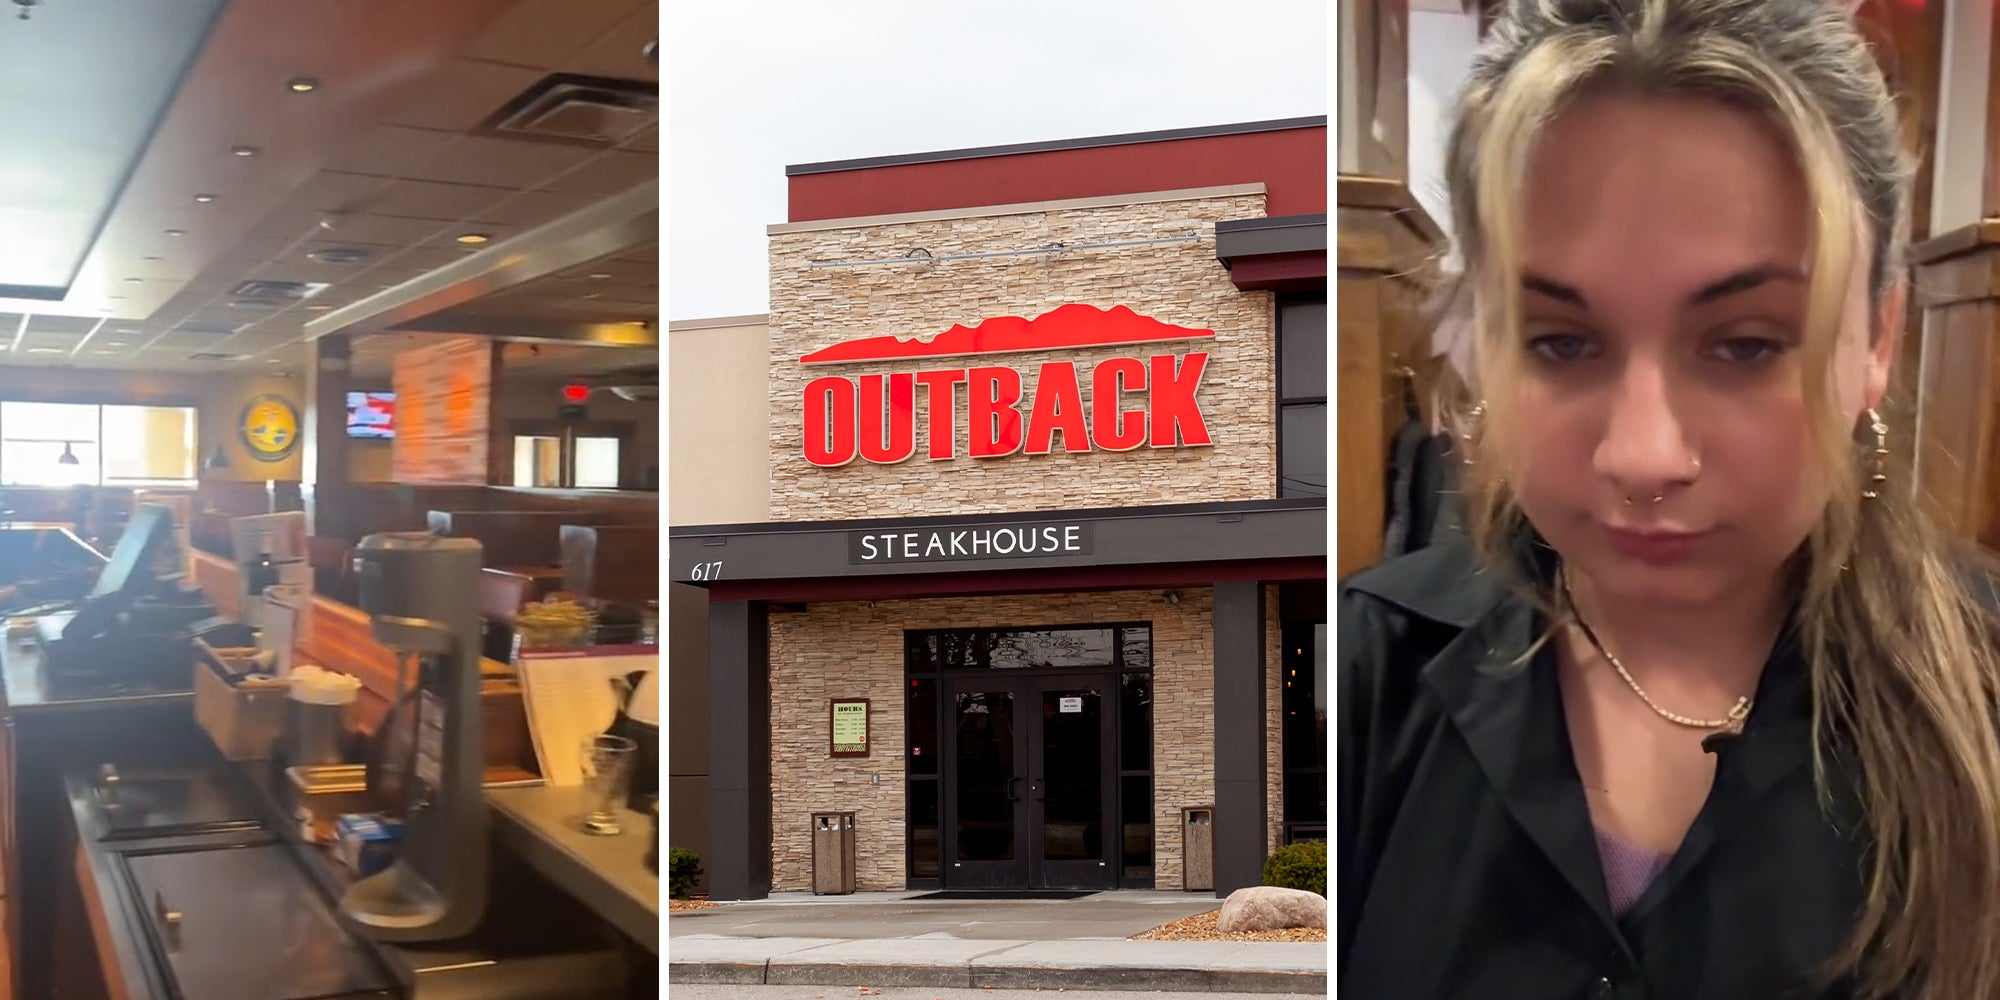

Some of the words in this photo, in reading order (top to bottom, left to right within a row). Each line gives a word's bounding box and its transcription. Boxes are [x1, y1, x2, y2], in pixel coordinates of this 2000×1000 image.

[803, 352, 1213, 468] OUTBACK
[861, 525, 1081, 560] STEAKHOUSE
[691, 561, 723, 581] 617
